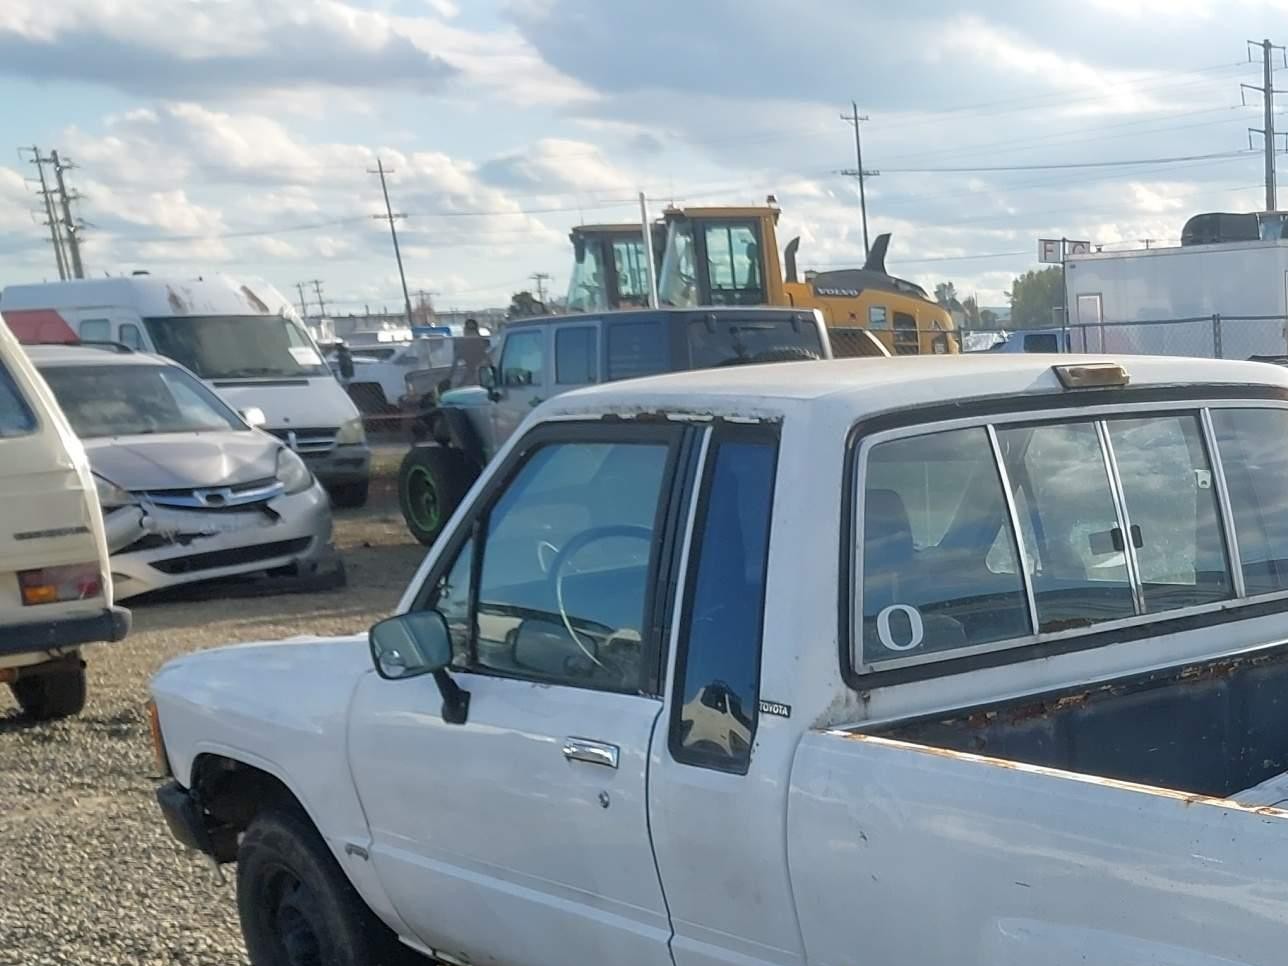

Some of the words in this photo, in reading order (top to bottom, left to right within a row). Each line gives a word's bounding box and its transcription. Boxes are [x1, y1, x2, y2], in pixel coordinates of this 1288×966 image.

[816, 287, 859, 297] VOLVO
[876, 603, 924, 651] O
[759, 701, 789, 717] TOYOTA
